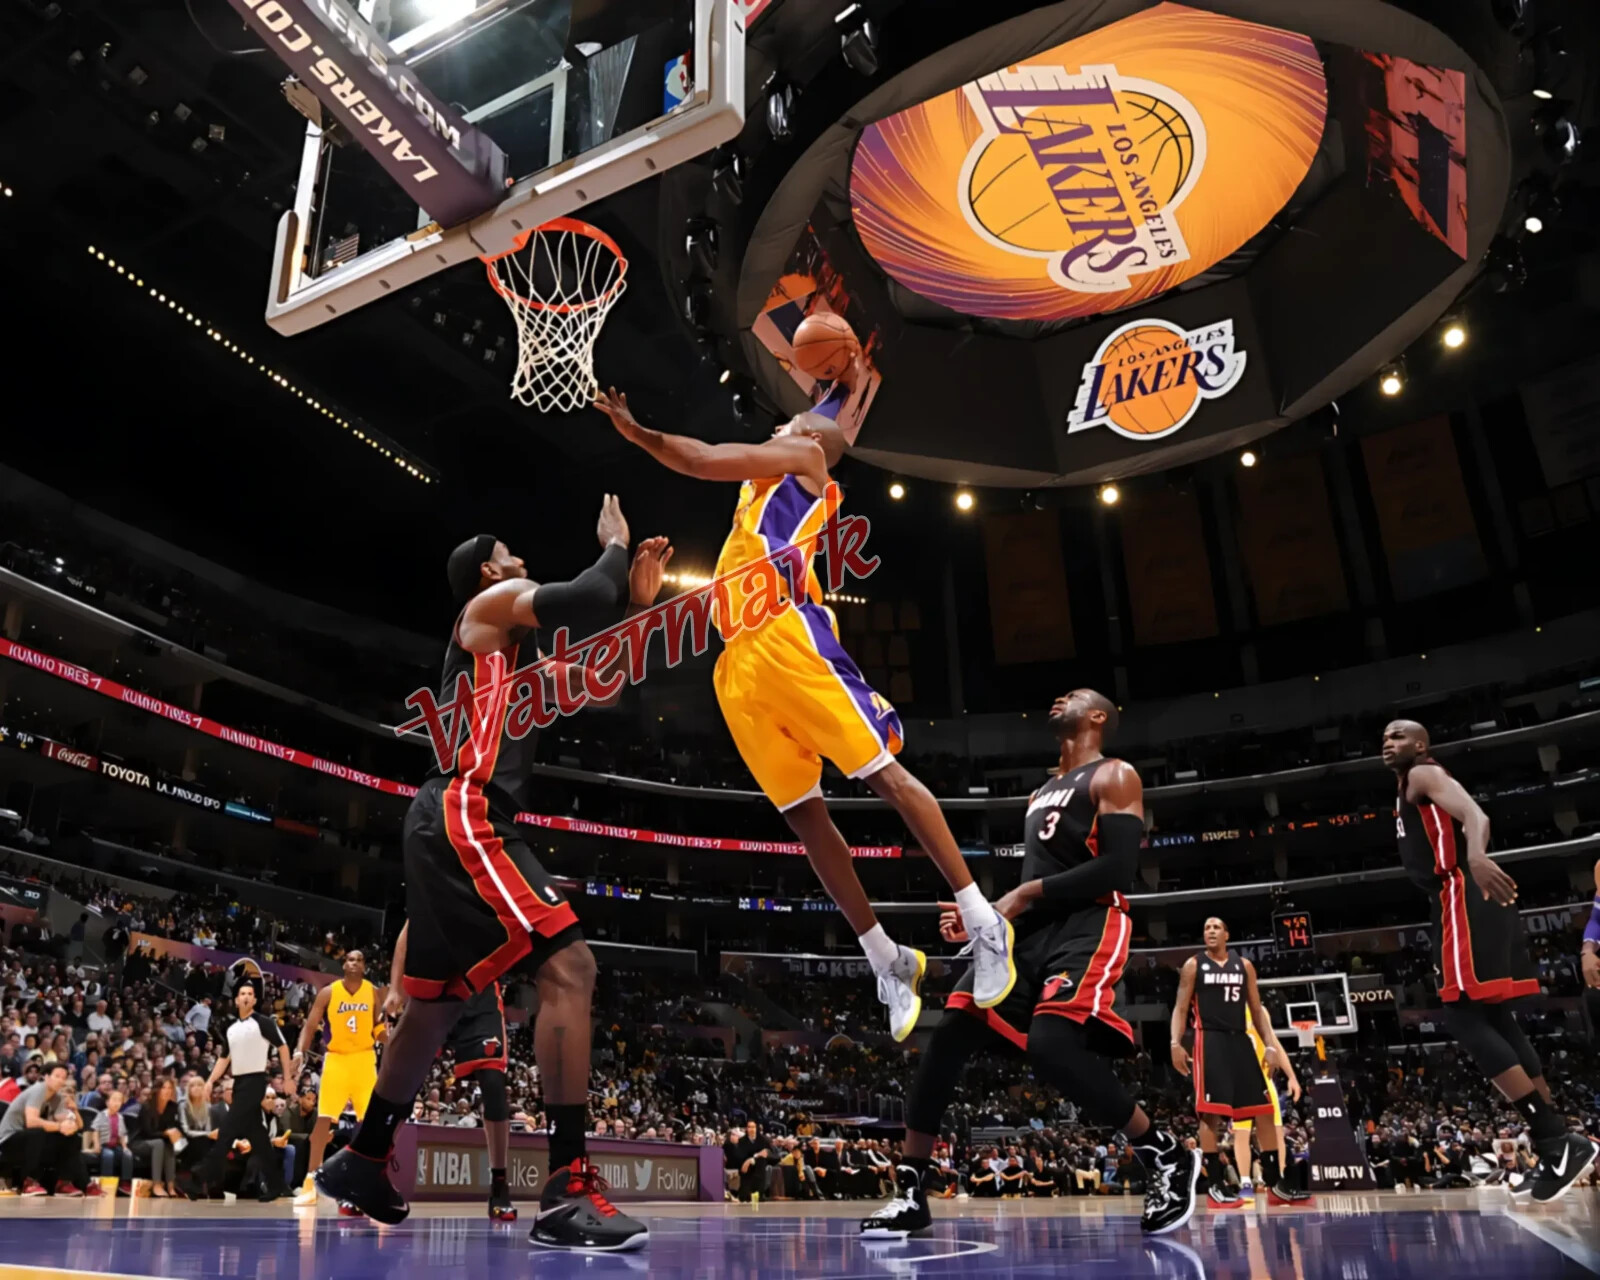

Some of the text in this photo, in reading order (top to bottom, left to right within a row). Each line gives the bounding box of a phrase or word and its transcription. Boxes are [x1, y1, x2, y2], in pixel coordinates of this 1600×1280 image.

[975, 76, 1148, 285] LAKERS
[1106, 123, 1177, 260] LOS ANGELES
[1118, 326, 1227, 367] LOS ANGELES
[1077, 343, 1239, 425] LAKERS
[58, 662, 89, 685] TIRES
[101, 761, 150, 788] TOYOTA
[1038, 811, 1060, 840] 3
[1289, 929, 1309, 948] 14
[1204, 973, 1244, 985] MIAMI
[1223, 986, 1241, 1002] 15
[1349, 989, 1394, 1003] OYOTA
[346, 1015, 358, 1034] 4
[433, 1151, 472, 1186] NBA
[508, 1157, 540, 1188] ike
[657, 1166, 697, 1191] Follow
[1348, 1166, 1364, 1179] TV
